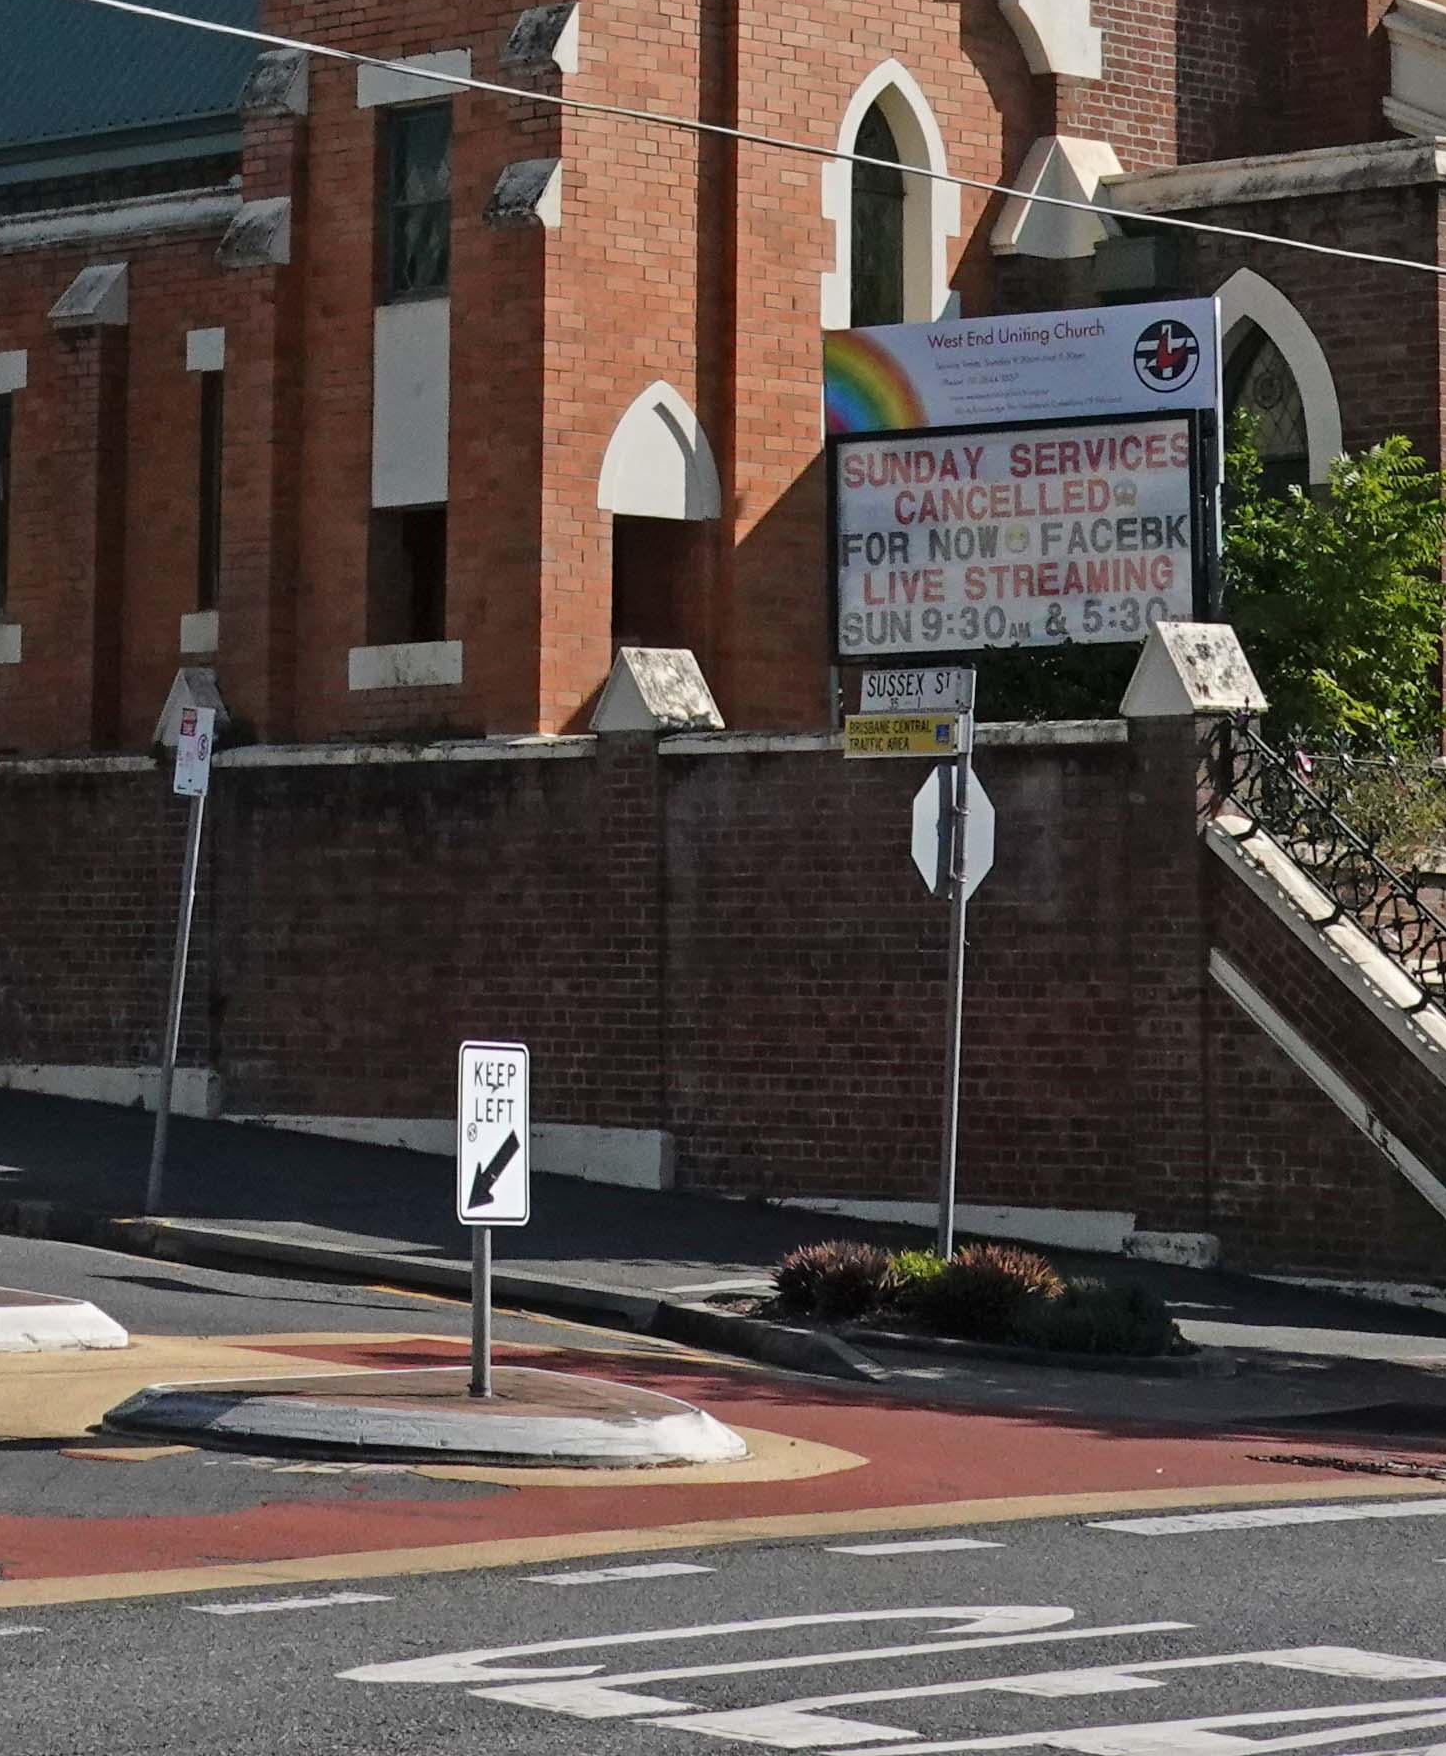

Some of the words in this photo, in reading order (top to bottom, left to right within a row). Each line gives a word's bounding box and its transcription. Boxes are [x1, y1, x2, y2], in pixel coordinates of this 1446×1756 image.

[927, 332, 963, 349] West
[967, 328, 994, 347] End
[999, 325, 1049, 346] Uniting
[1054, 317, 1105, 340] Church
[843, 446, 984, 488] SUNDAY
[1010, 431, 1188, 478] SERVICES
[895, 478, 1110, 525] CANCELLED
[840, 531, 910, 567] FOR
[929, 525, 999, 562] NOW
[1040, 514, 1188, 556] FACEBK
[863, 568, 945, 605] LIVE
[964, 554, 1174, 601] STREAMING
[840, 609, 912, 646] SUN
[1044, 601, 1068, 637] &
[867, 672, 925, 697] SUSSEX
[934, 672, 951, 694] ST
[849, 719, 890, 735] BRISBANE
[893, 718, 932, 734] CENTRAL
[849, 737, 884, 752] TRAFFIC
[887, 736, 910, 751] AREA
[474, 1061, 517, 1088] KEEP
[475, 1098, 515, 1123] LEFT
